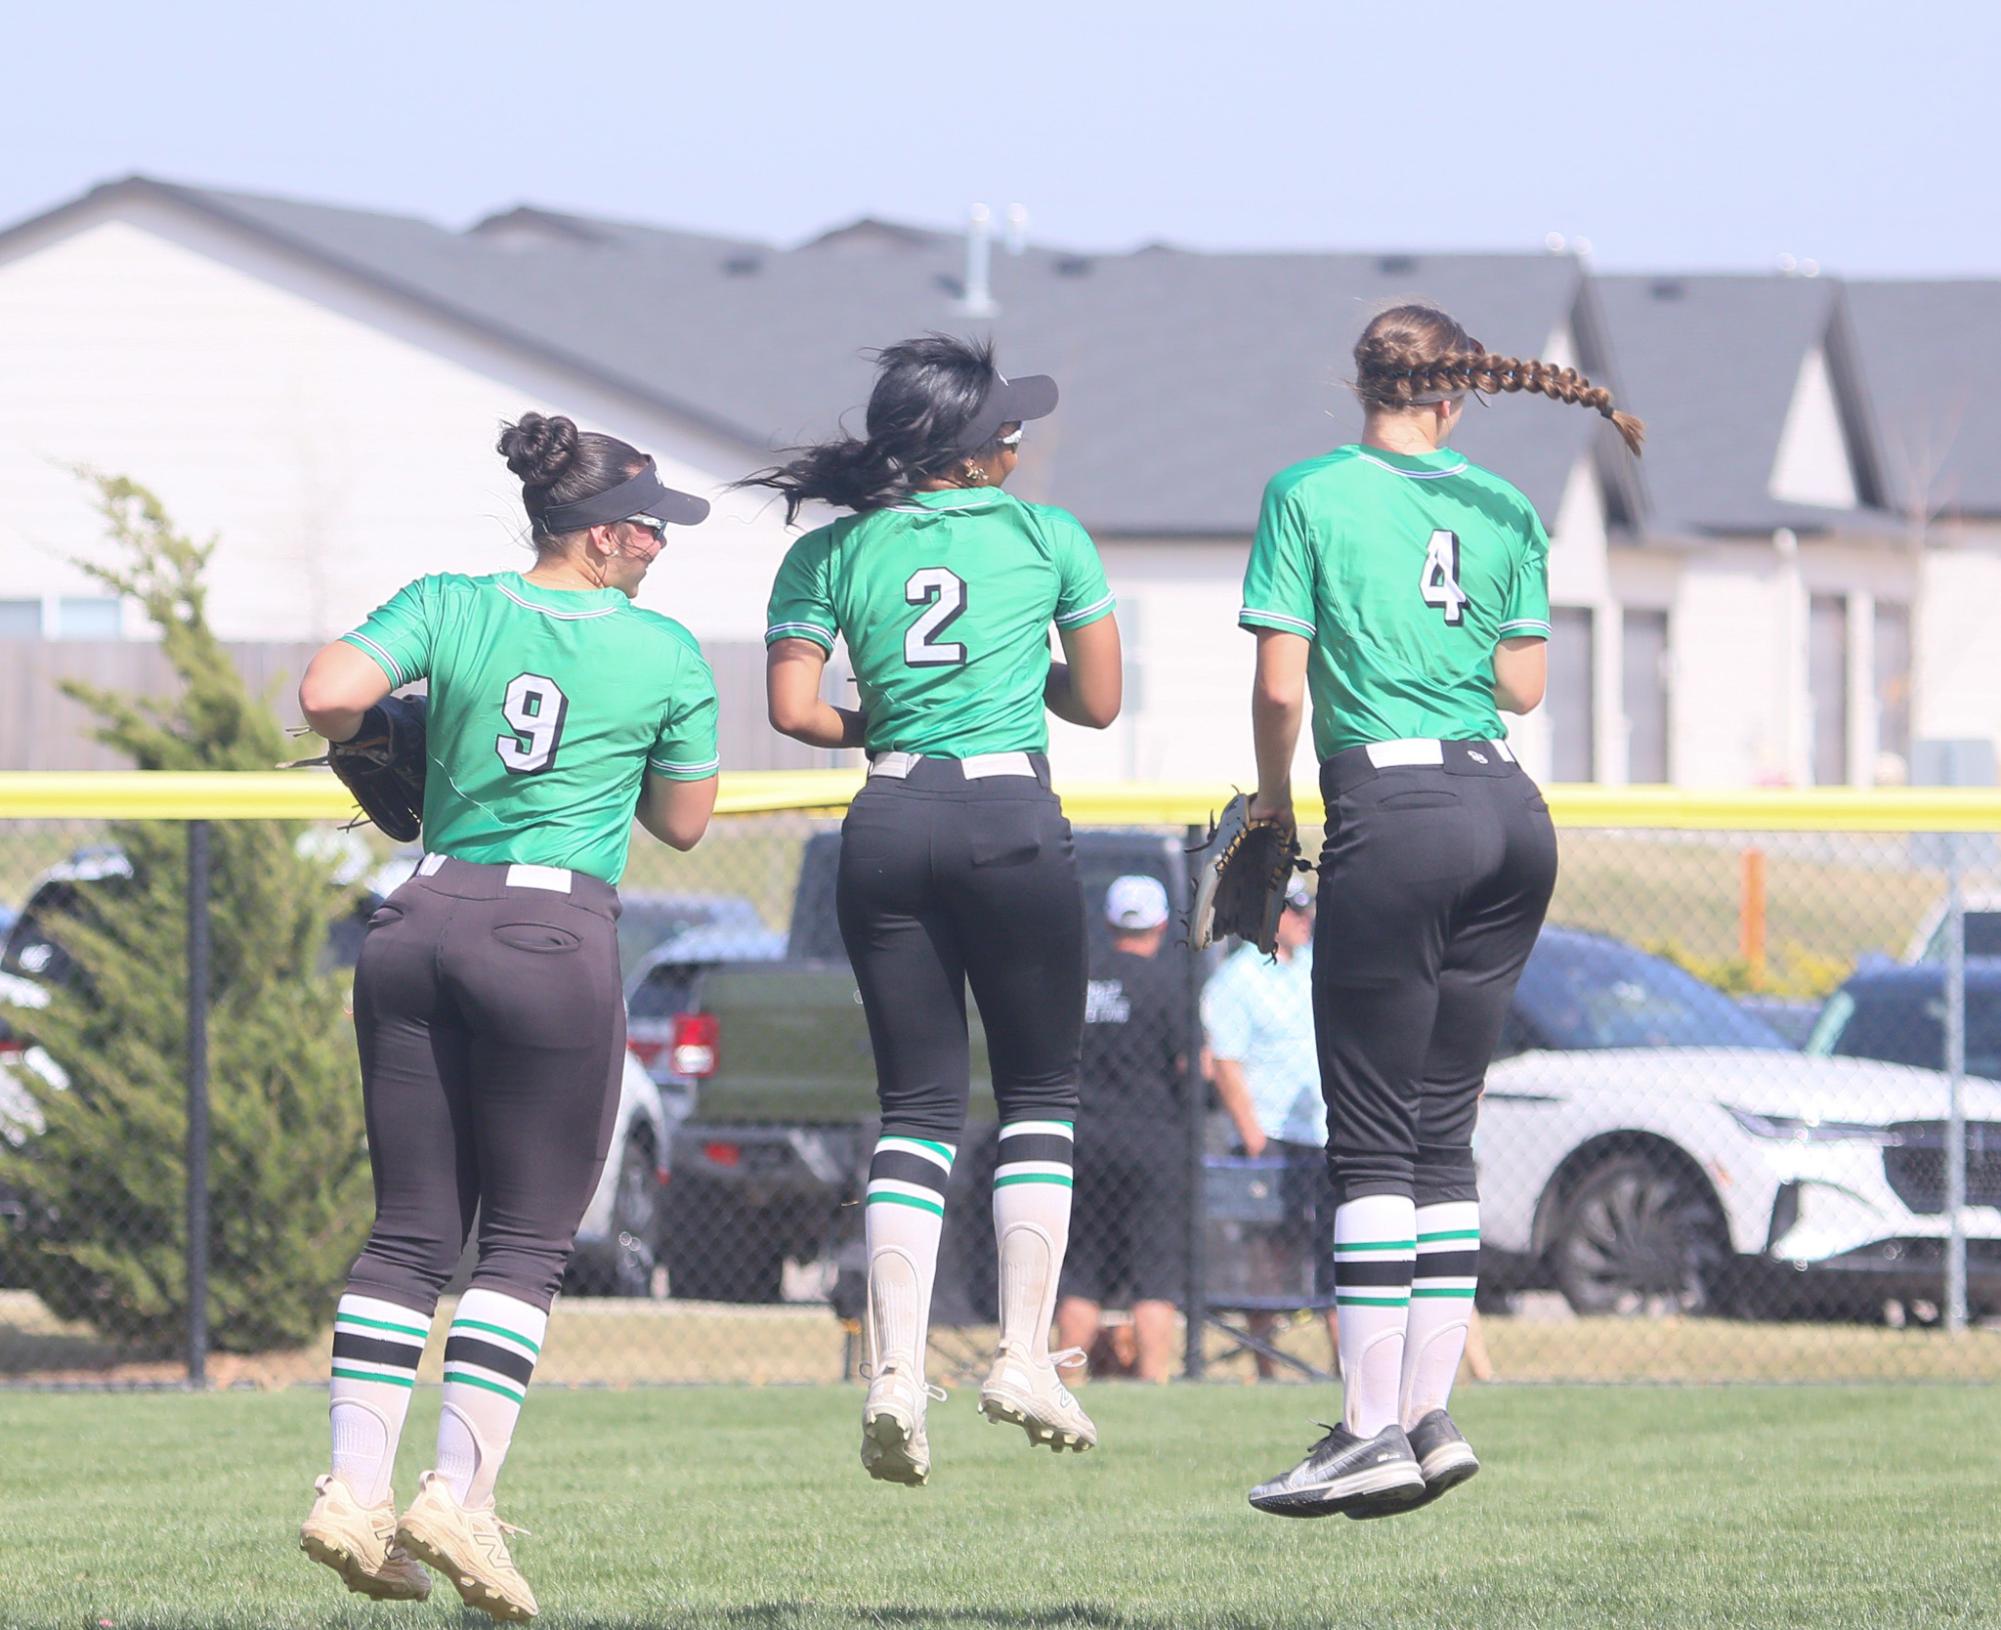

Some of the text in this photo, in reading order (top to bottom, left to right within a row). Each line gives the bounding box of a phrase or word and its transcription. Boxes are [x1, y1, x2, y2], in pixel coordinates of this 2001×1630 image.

[904, 566, 968, 669] 2
[1418, 528, 1472, 628] 4
[495, 671, 570, 776] 9
